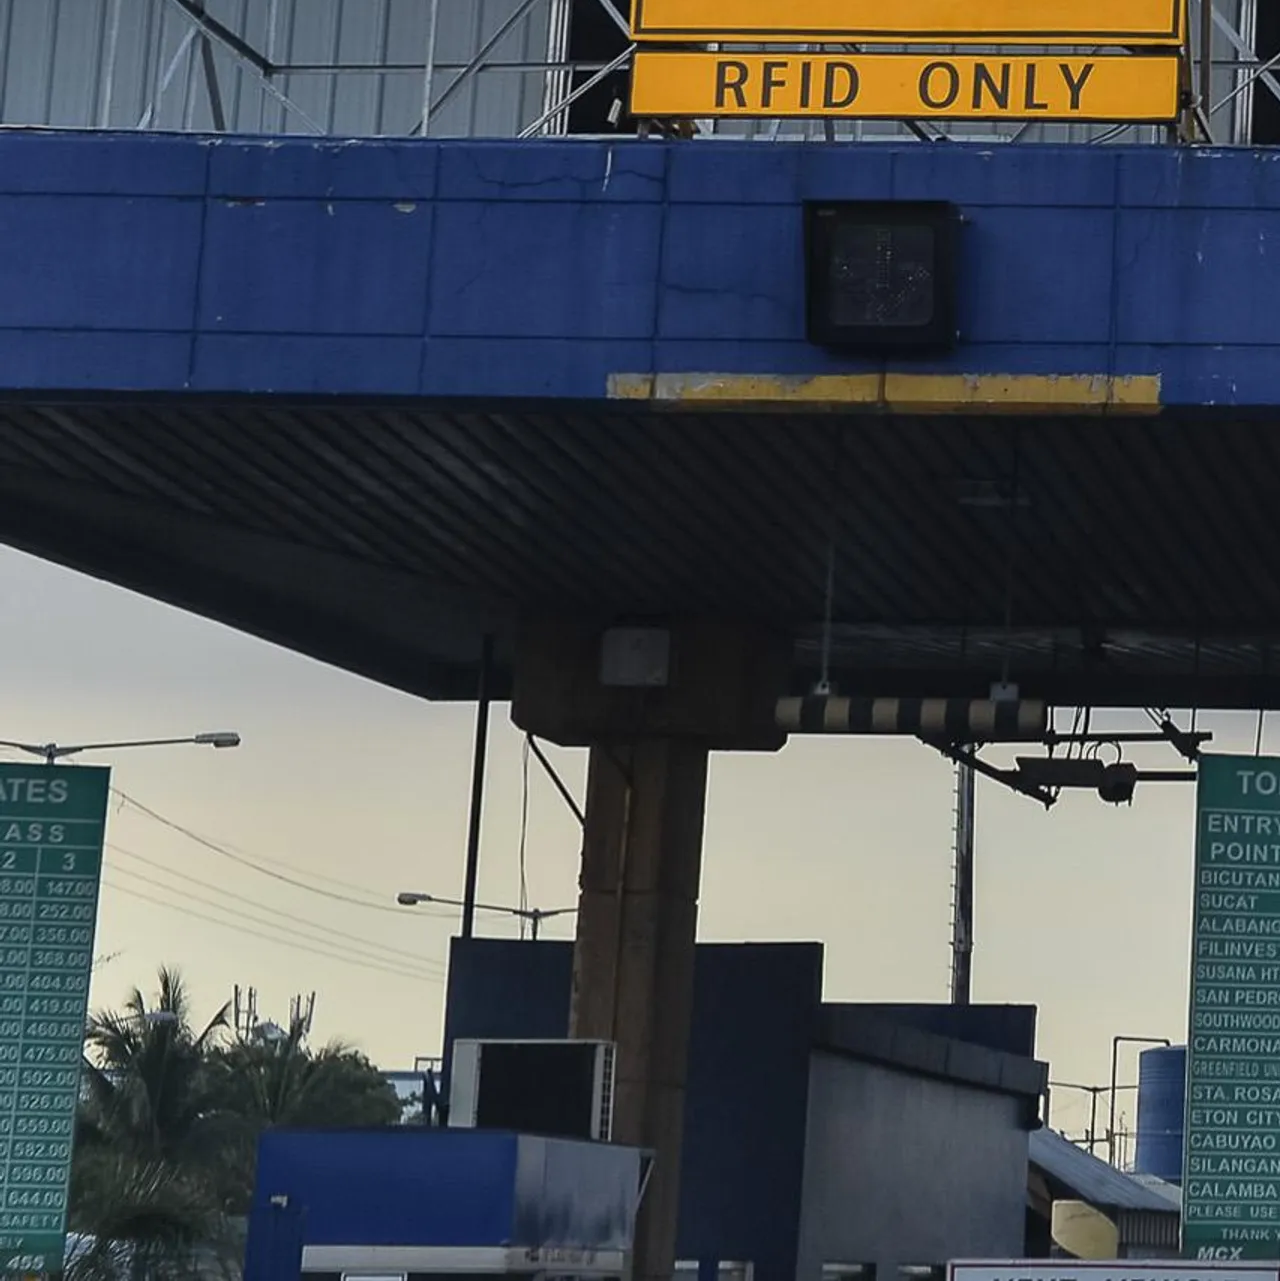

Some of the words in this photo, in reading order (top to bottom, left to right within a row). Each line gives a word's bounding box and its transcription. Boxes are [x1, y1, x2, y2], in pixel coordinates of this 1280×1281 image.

[715, 61, 860, 108] RFID
[919, 62, 1094, 111] ONLY
[0, 778, 69, 803] TES
[1, 851, 16, 869] 2
[63, 853, 75, 870] 3
[1202, 871, 1280, 887] BICUTAN
[1201, 894, 1258, 909] SUCAT
[1198, 965, 1255, 980] SUSANA
[1197, 989, 1230, 1003] SAN
[1192, 1110, 1237, 1124] ETON
[1191, 1135, 1275, 1149] CABUYAO
[1189, 1183, 1277, 1197] CALAMBA
[1189, 1206, 1240, 1217] PLEASE
[1251, 1207, 1276, 1218] USE
[1221, 1229, 1269, 1240] THANK
[1198, 1247, 1243, 1261] MCX
